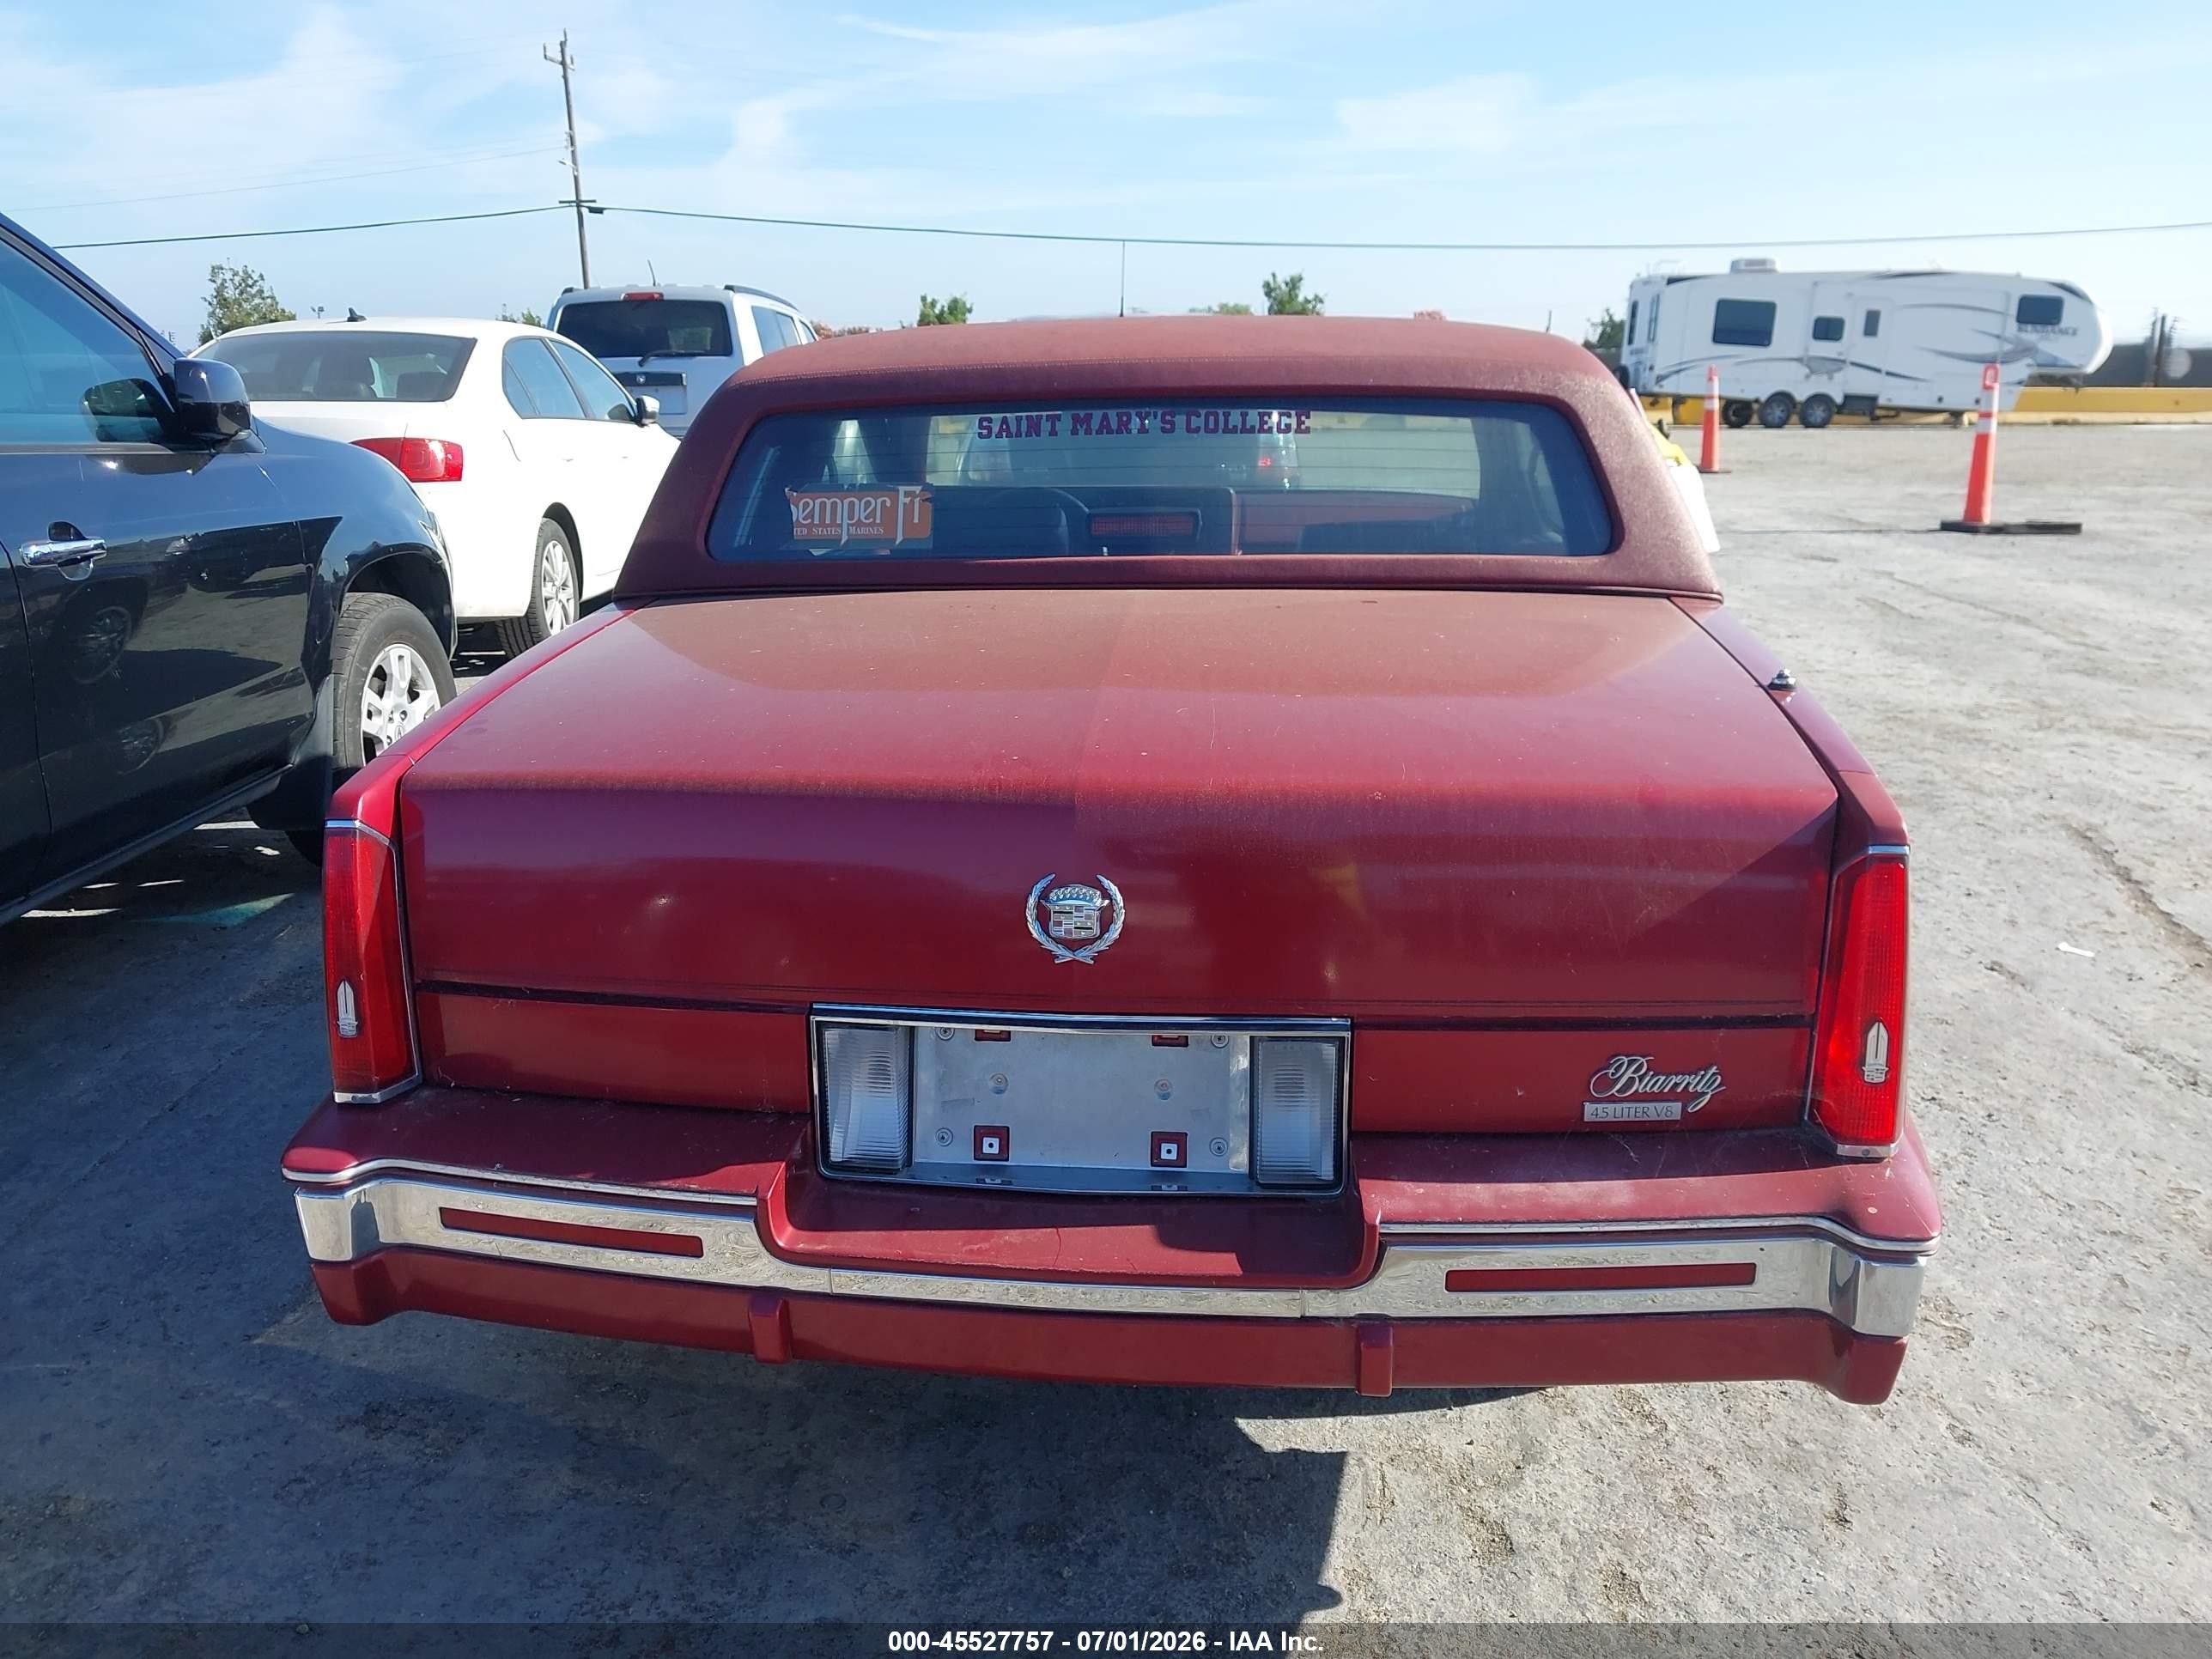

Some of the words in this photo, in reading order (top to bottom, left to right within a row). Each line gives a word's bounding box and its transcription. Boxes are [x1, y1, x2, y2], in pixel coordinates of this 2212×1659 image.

[977, 413, 1061, 439] SAINT
[1070, 410, 1176, 435] MARY'S
[1185, 410, 1311, 434] COLLEGE
[812, 526, 842, 536] STATES
[849, 526, 884, 535] MARINES
[1590, 1055, 1727, 1114] Biarritz
[1613, 1105, 1650, 1119] LITER
[1654, 1105, 1674, 1118] V8
